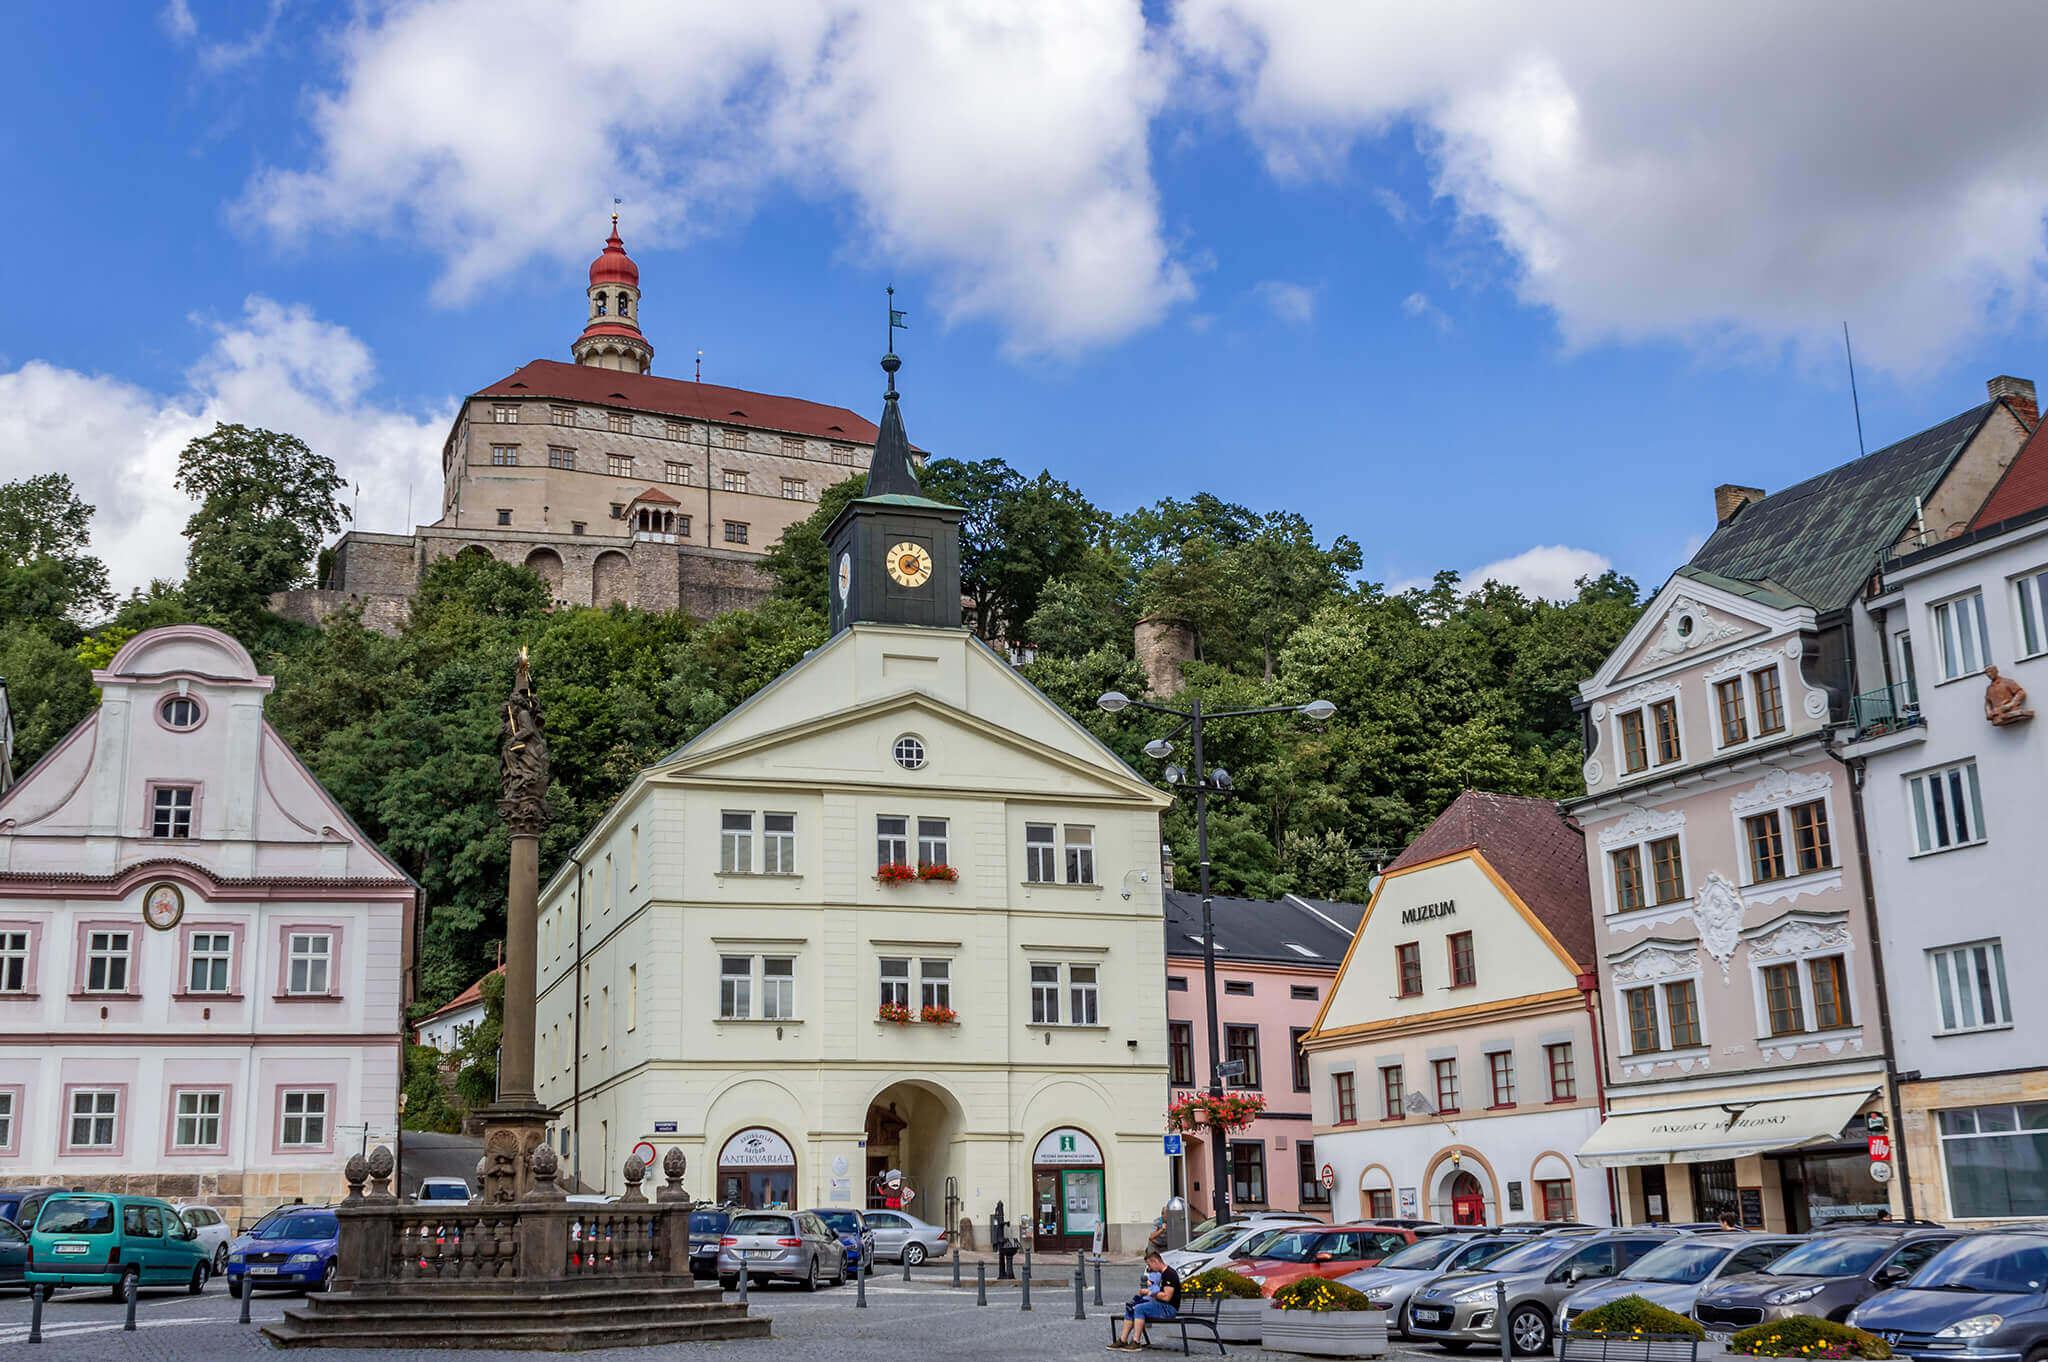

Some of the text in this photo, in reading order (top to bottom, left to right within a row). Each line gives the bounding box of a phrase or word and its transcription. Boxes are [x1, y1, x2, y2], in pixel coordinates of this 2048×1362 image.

[1401, 899, 1456, 925] MUZEUM
[1870, 1139, 1889, 1158] illy
[724, 1153, 789, 1164] ANTIKVARIÁT
